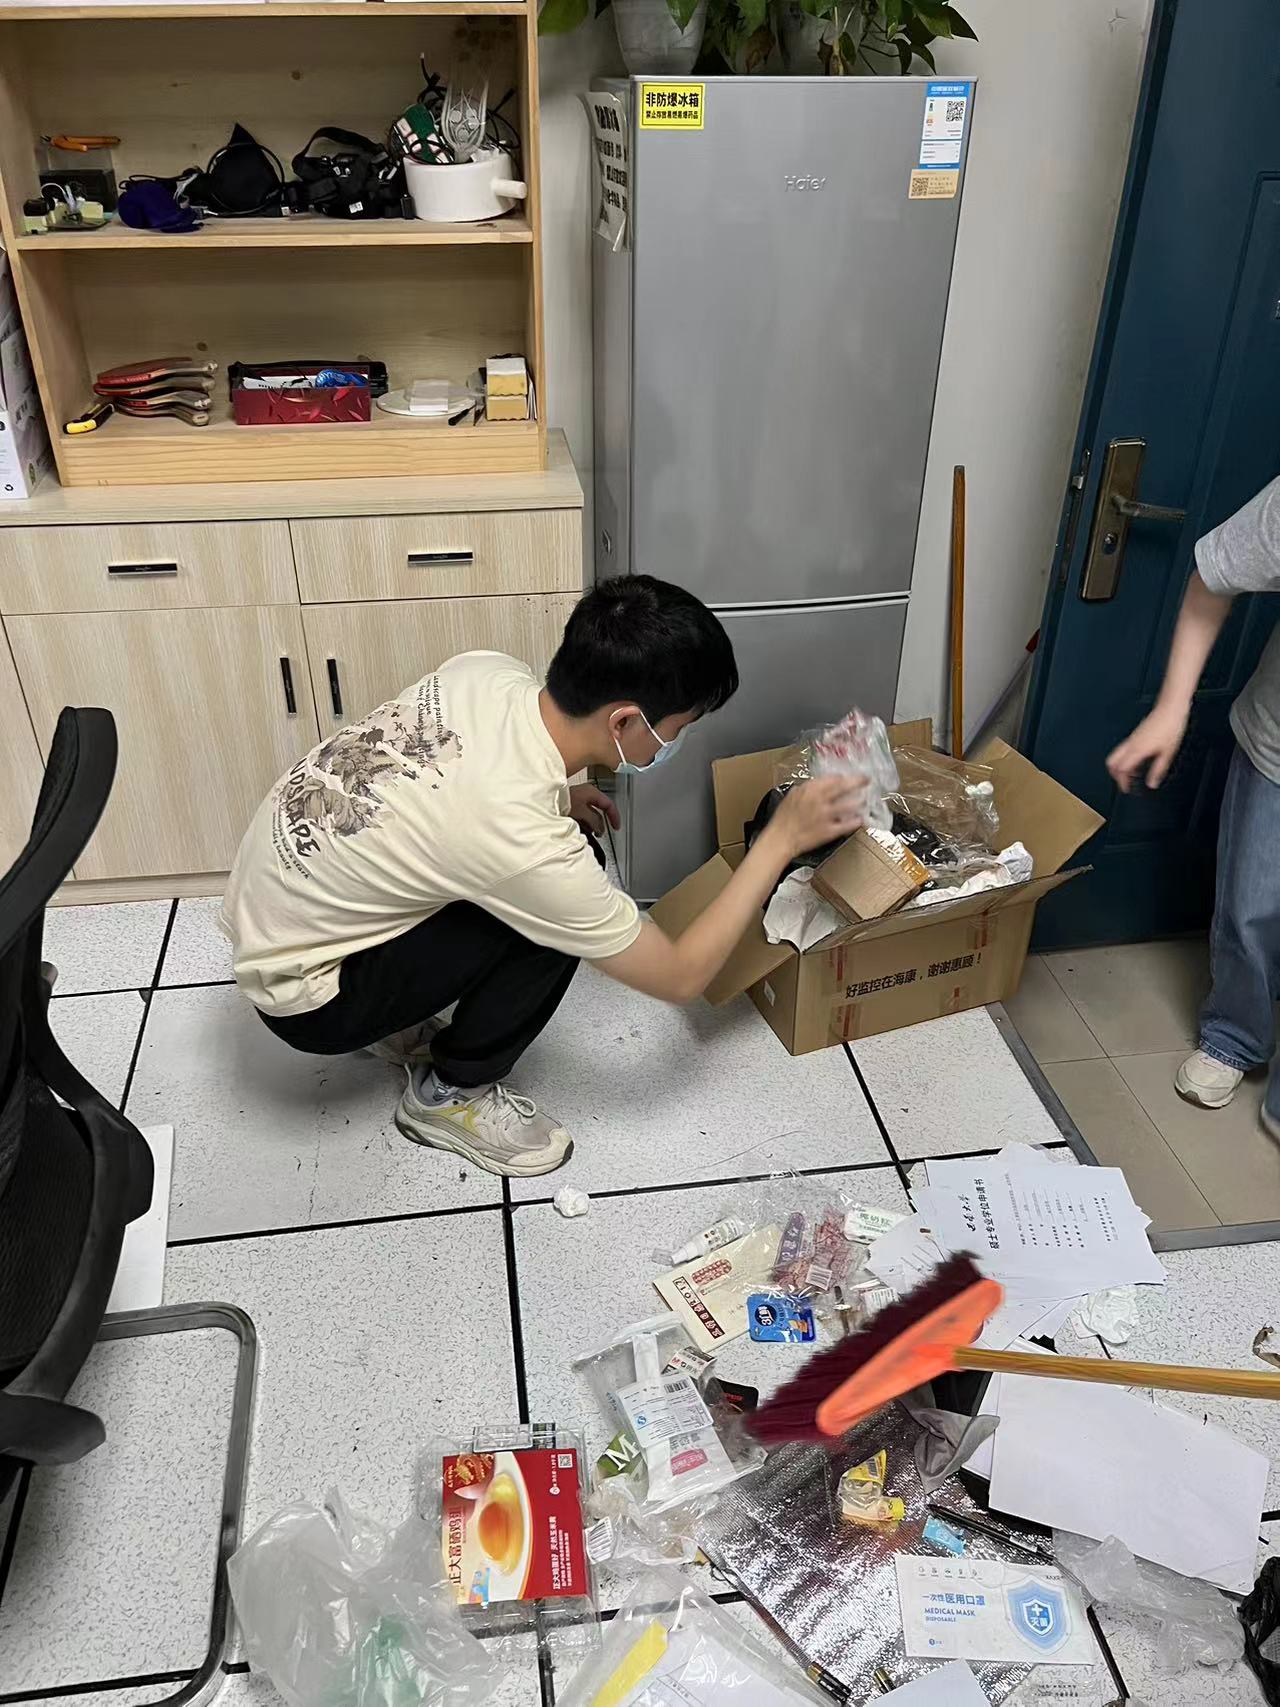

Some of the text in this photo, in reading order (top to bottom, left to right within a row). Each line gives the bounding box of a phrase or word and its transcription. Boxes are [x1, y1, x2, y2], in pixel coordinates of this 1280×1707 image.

[645, 91, 700, 107] 非防爆冰箱
[784, 174, 827, 191] Haier
[974, 1178, 1000, 1249] 硕士专业学位申请书
[922, 1593, 986, 1606] 一次性医用口罩
[924, 1607, 976, 1617] MEDICAL MASK
